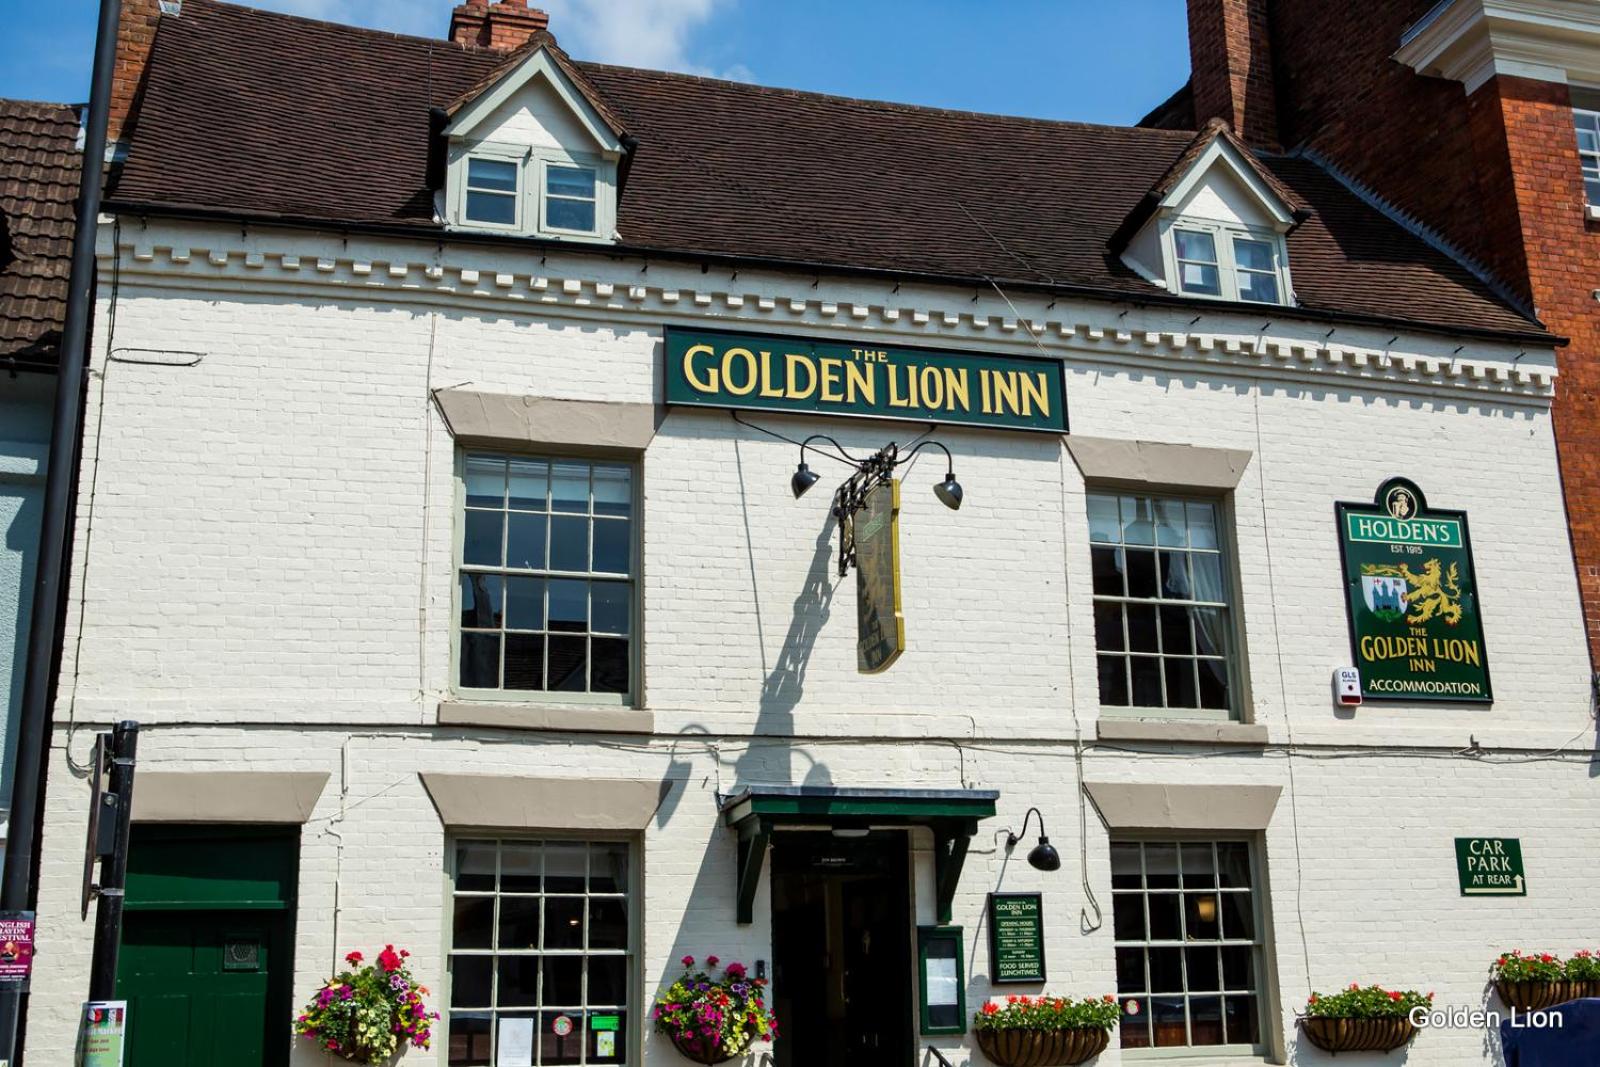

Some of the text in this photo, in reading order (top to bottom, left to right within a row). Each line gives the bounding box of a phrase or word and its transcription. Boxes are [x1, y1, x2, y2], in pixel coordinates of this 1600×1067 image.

[851, 348, 889, 363] THE
[683, 344, 1050, 418] GOLDEN LION INN
[1358, 518, 1451, 542] HOLDEN'S
[1409, 627, 1428, 637] THE
[1360, 635, 1480, 667] GOLDEN LION
[1409, 659, 1436, 673] INN
[1369, 679, 1481, 695] ACCOMMODATION
[1469, 839, 1505, 855] CAR
[1466, 856, 1513, 872] PARK
[1472, 874, 1512, 885] AT REAR
